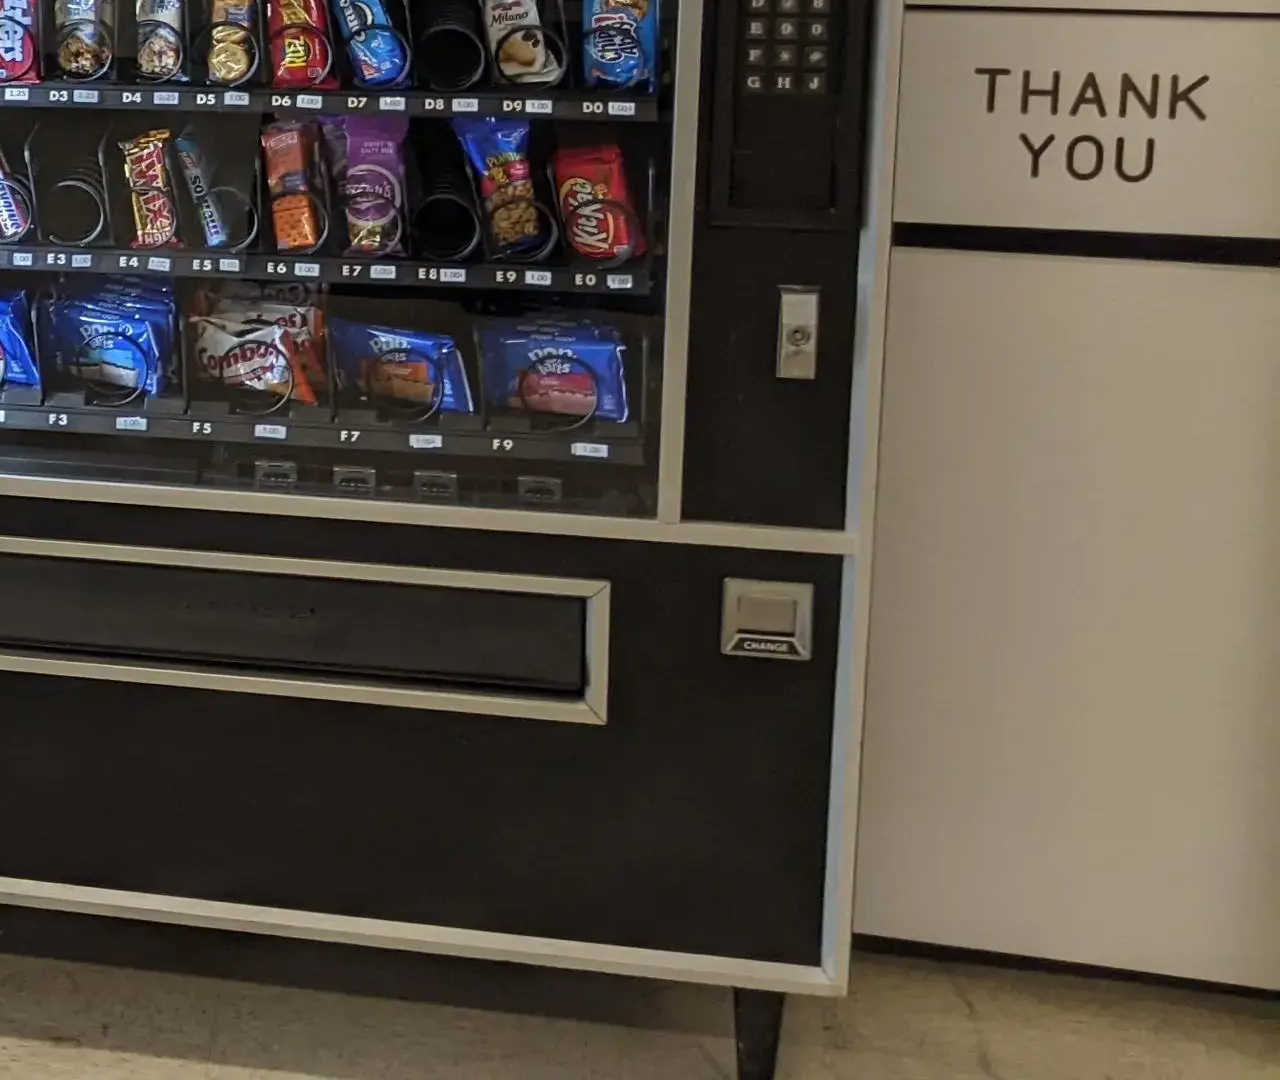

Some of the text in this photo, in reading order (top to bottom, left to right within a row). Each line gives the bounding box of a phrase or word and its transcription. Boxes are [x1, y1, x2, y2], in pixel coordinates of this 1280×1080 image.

[490, 10, 529, 26] Milano
[50, 91, 68, 101] D3
[123, 93, 141, 102] D4
[197, 94, 215, 104] D5
[973, 67, 1210, 122] THANK
[272, 96, 291, 106] D6
[348, 98, 367, 107] D7
[425, 99, 444, 109] D8
[503, 101, 522, 111] D9
[583, 102, 603, 112] D0
[1018, 132, 1156, 183] YOU
[47, 254, 65, 264] E3
[120, 257, 138, 267] E4
[193, 260, 211, 270] E5
[268, 263, 286, 273] E6
[343, 266, 361, 276] E7
[419, 268, 437, 279] E8
[496, 271, 516, 282] E9
[576, 274, 595, 285] E0
[49, 414, 67, 425] F3
[193, 423, 211, 433] F5
[341, 431, 360, 441] F7
[493, 439, 512, 450] F9
[743, 639, 789, 653] CHANGE
